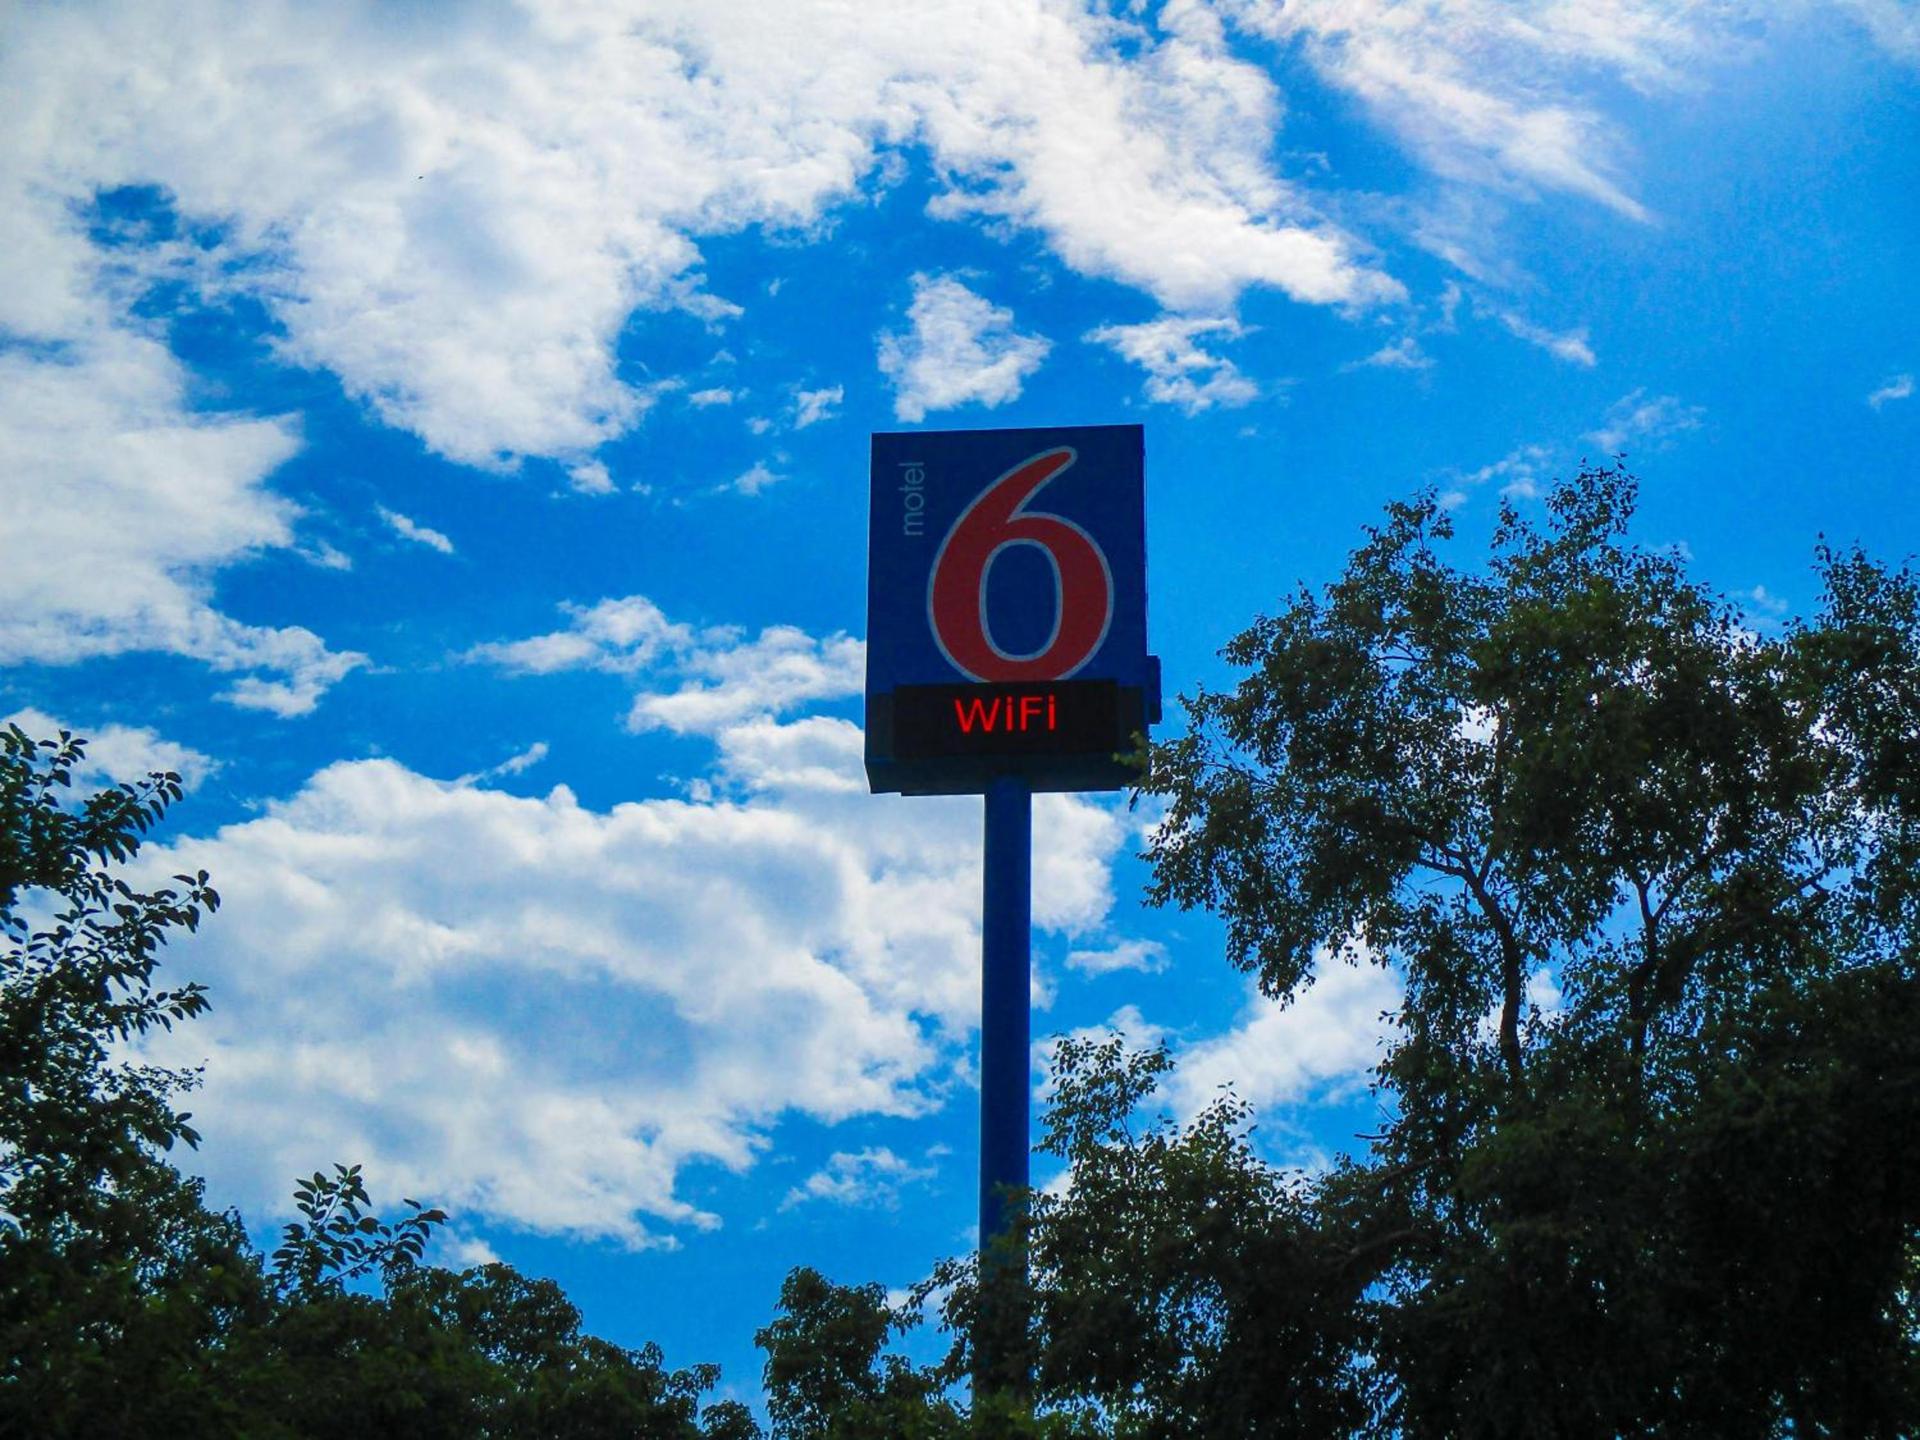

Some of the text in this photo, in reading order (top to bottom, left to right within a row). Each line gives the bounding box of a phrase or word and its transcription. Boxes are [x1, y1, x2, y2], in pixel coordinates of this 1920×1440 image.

[898, 445, 1114, 683] motel 6
[954, 693, 1056, 733] WiFi
